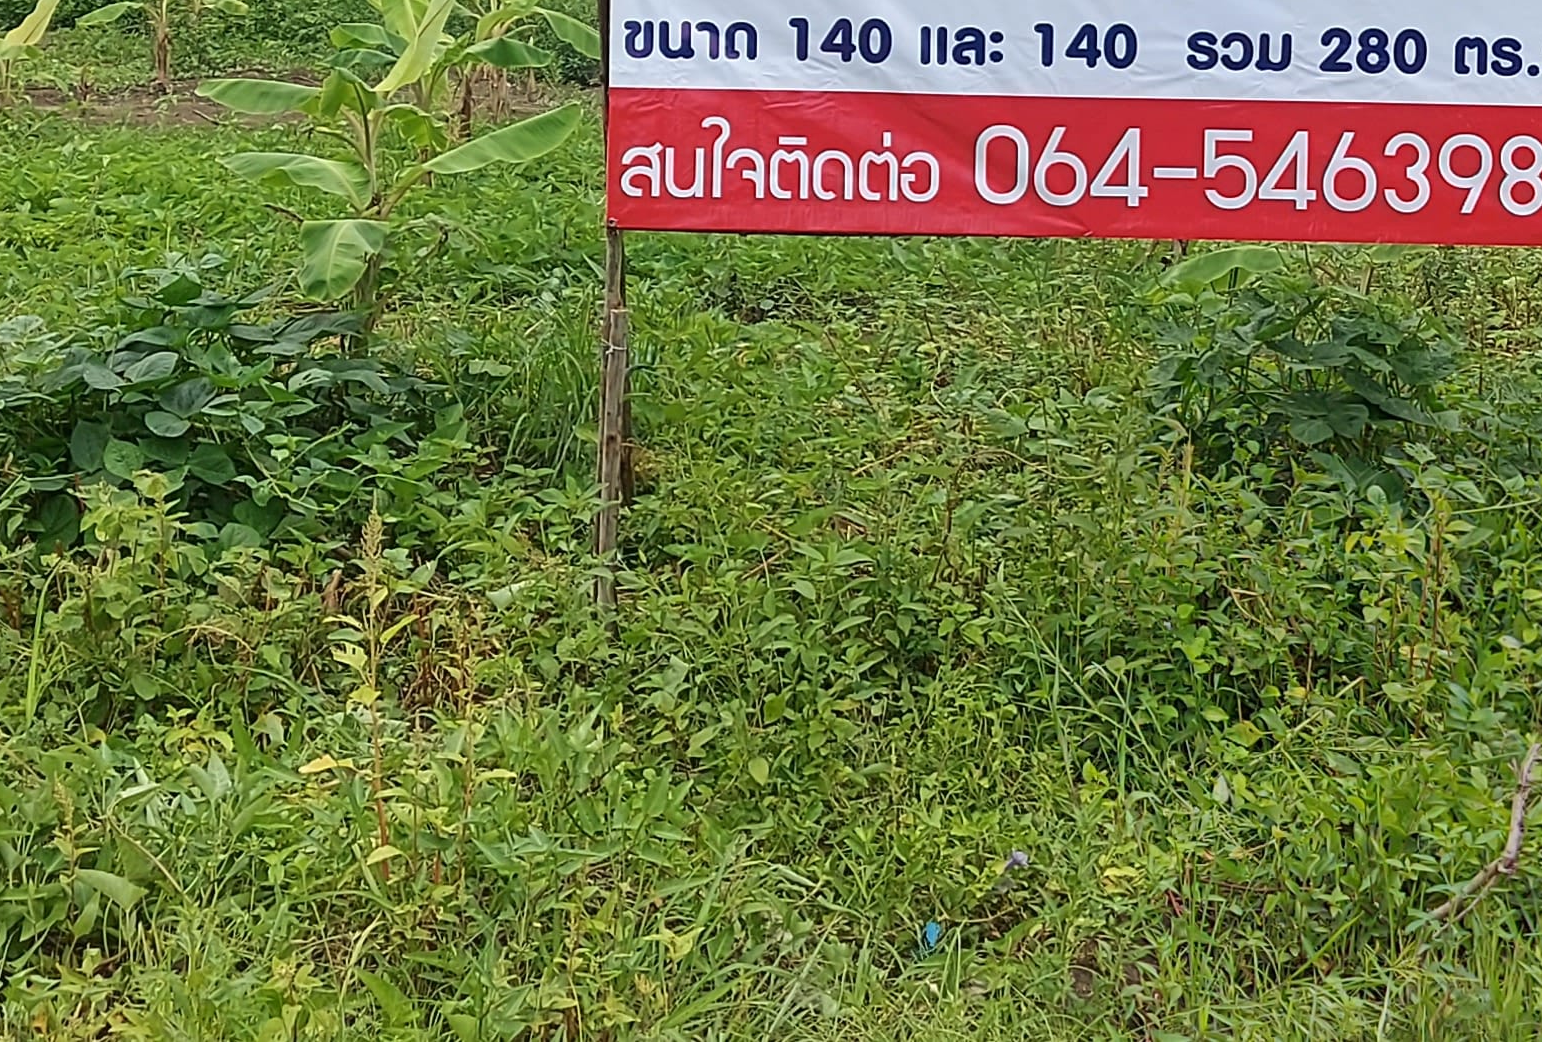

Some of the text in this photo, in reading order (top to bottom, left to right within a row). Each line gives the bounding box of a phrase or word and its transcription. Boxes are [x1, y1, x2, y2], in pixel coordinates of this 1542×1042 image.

[625, 21, 757, 60] ขนาด
[789, 18, 892, 63] 140
[921, 27, 1003, 65] และ
[1034, 24, 1137, 69] 140
[1187, 32, 1291, 71] รวม
[1320, 28, 1427, 74] 280
[621, 117, 939, 201] สนใจติดต่อ
